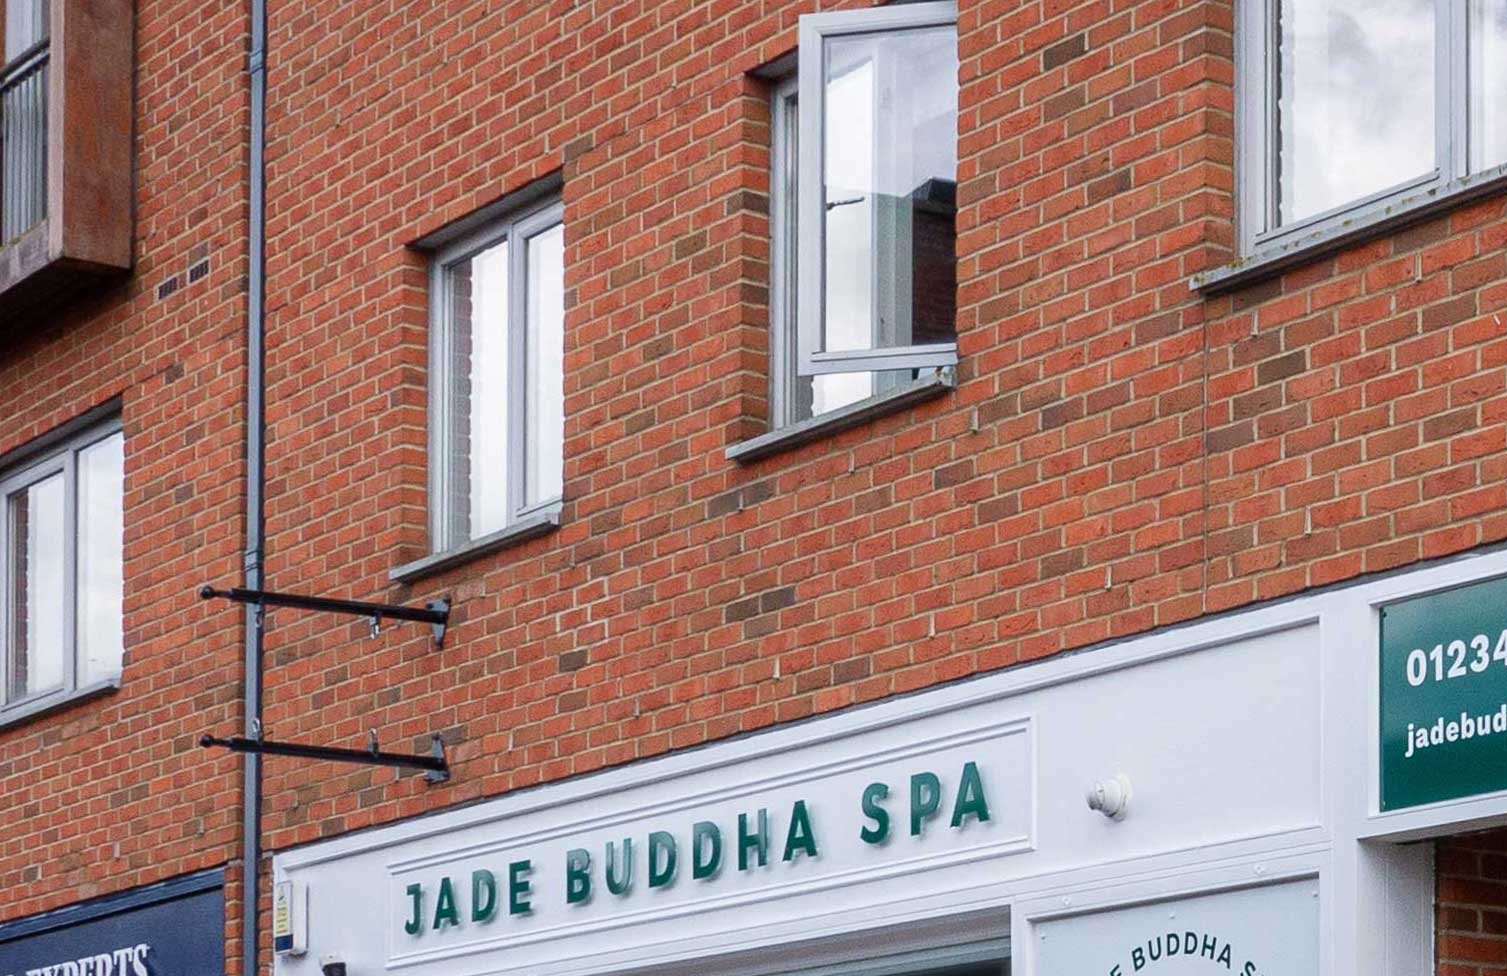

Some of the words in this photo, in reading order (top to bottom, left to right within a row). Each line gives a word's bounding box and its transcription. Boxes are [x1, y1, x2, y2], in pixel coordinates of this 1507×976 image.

[404, 860, 532, 936] JADE
[565, 800, 819, 904] BUDDHA
[860, 760, 991, 845] SPA
[1131, 932, 1232, 972] BUDDHA
